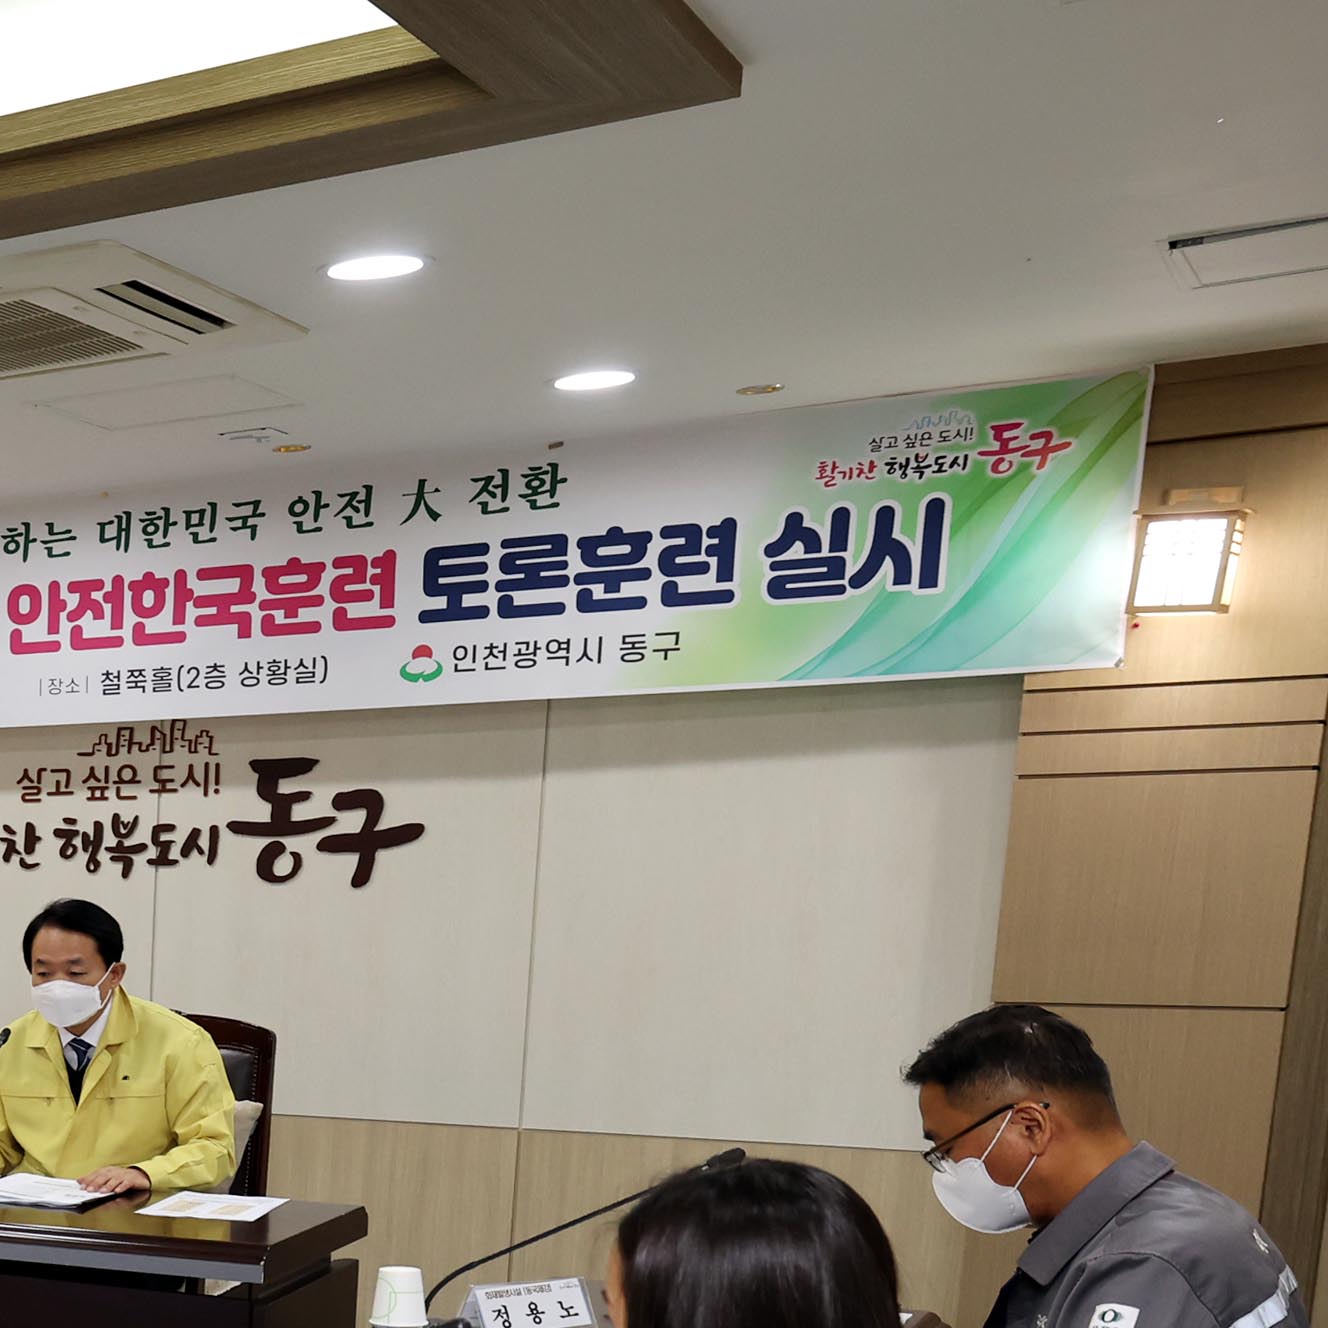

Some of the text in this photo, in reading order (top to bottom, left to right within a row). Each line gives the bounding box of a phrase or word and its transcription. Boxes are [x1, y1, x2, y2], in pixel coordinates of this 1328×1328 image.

[815, 421, 1073, 488] 활기찬 행복도시 동구
[868, 427, 974, 453] 살고 싶은 도시!
[0, 521, 77, 563] 하는
[97, 499, 266, 553] 대한민국
[287, 484, 374, 534] 안전
[399, 478, 444, 527] 大
[468, 462, 569, 516] 전환
[6, 548, 397, 656] 안전한국훈련
[417, 516, 738, 625] 토론훈련
[763, 497, 947, 601] 실시
[99, 662, 227, 697] 철쭉홀(2층
[237, 655, 329, 689] 상황실)
[451, 630, 682, 674] 인천광역시 동구
[16, 761, 222, 804] 살고 싶은 도시!
[53, 812, 220, 880] 행복도시
[226, 756, 426, 889] 동구
